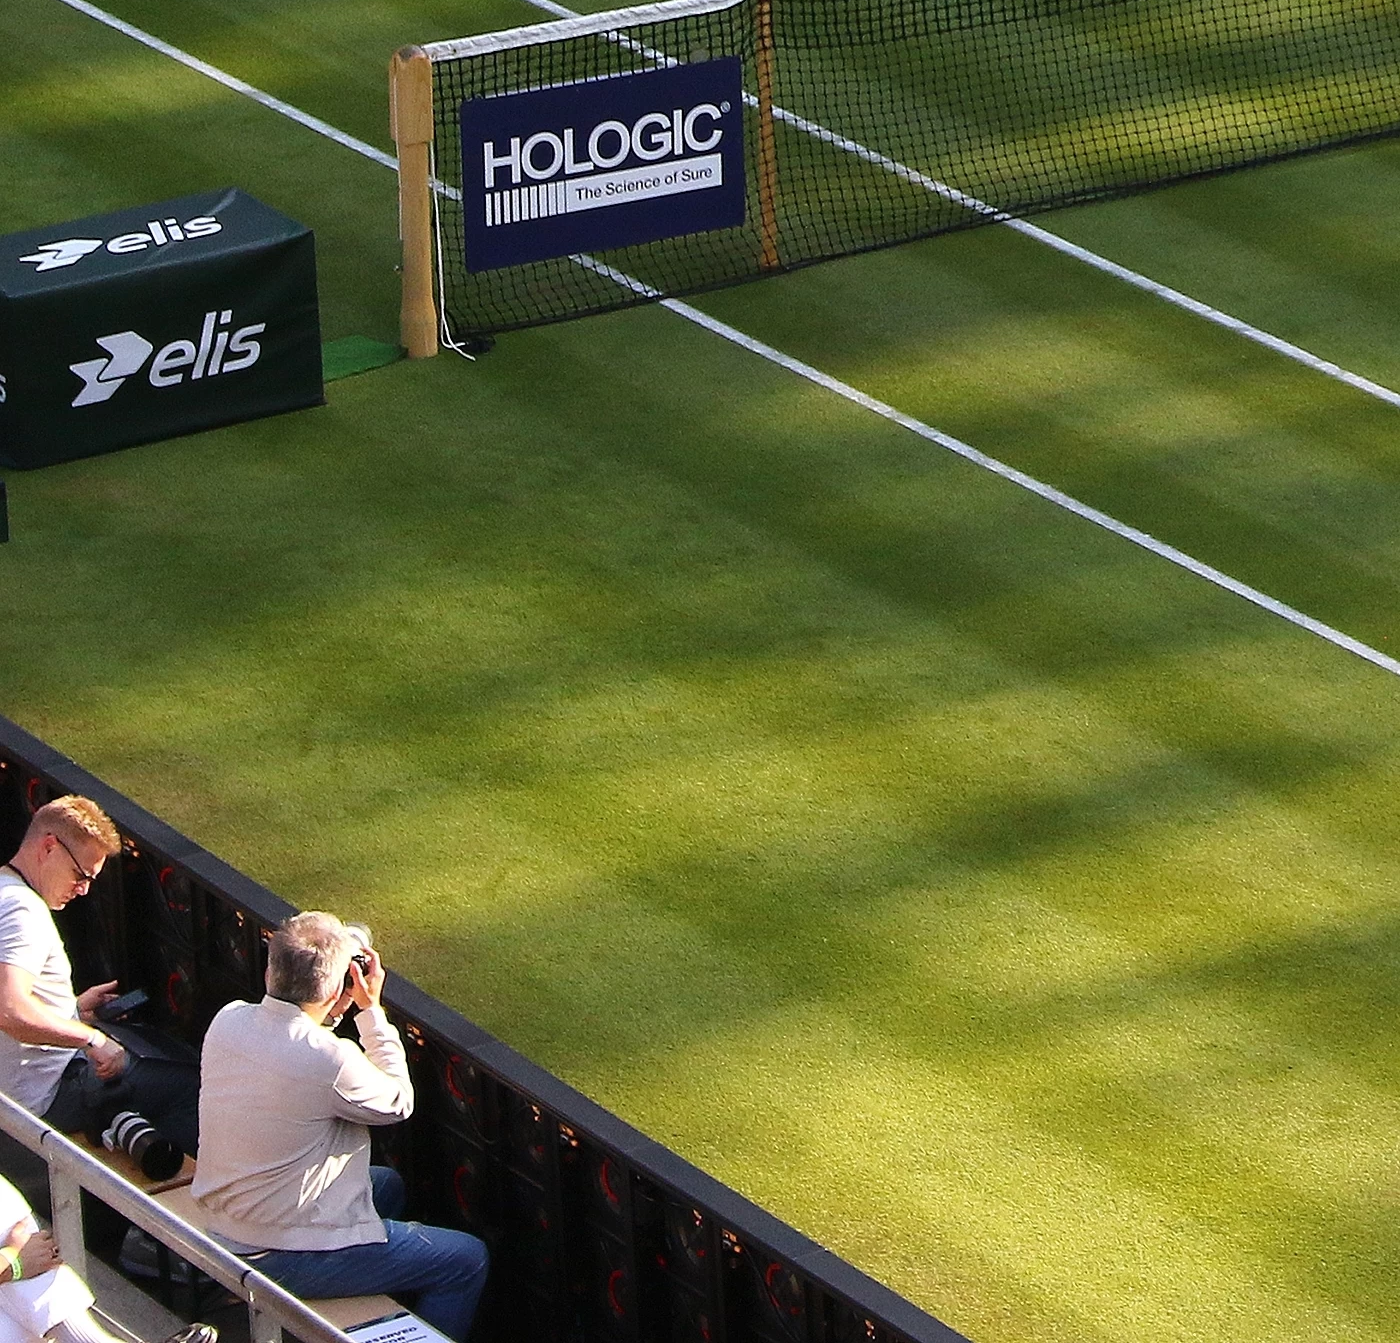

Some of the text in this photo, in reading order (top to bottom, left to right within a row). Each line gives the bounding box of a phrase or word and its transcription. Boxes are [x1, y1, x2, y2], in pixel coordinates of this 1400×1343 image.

[575, 166, 713, 201] The Science of Sure
[106, 216, 222, 254] elis
[149, 309, 266, 388] elis
